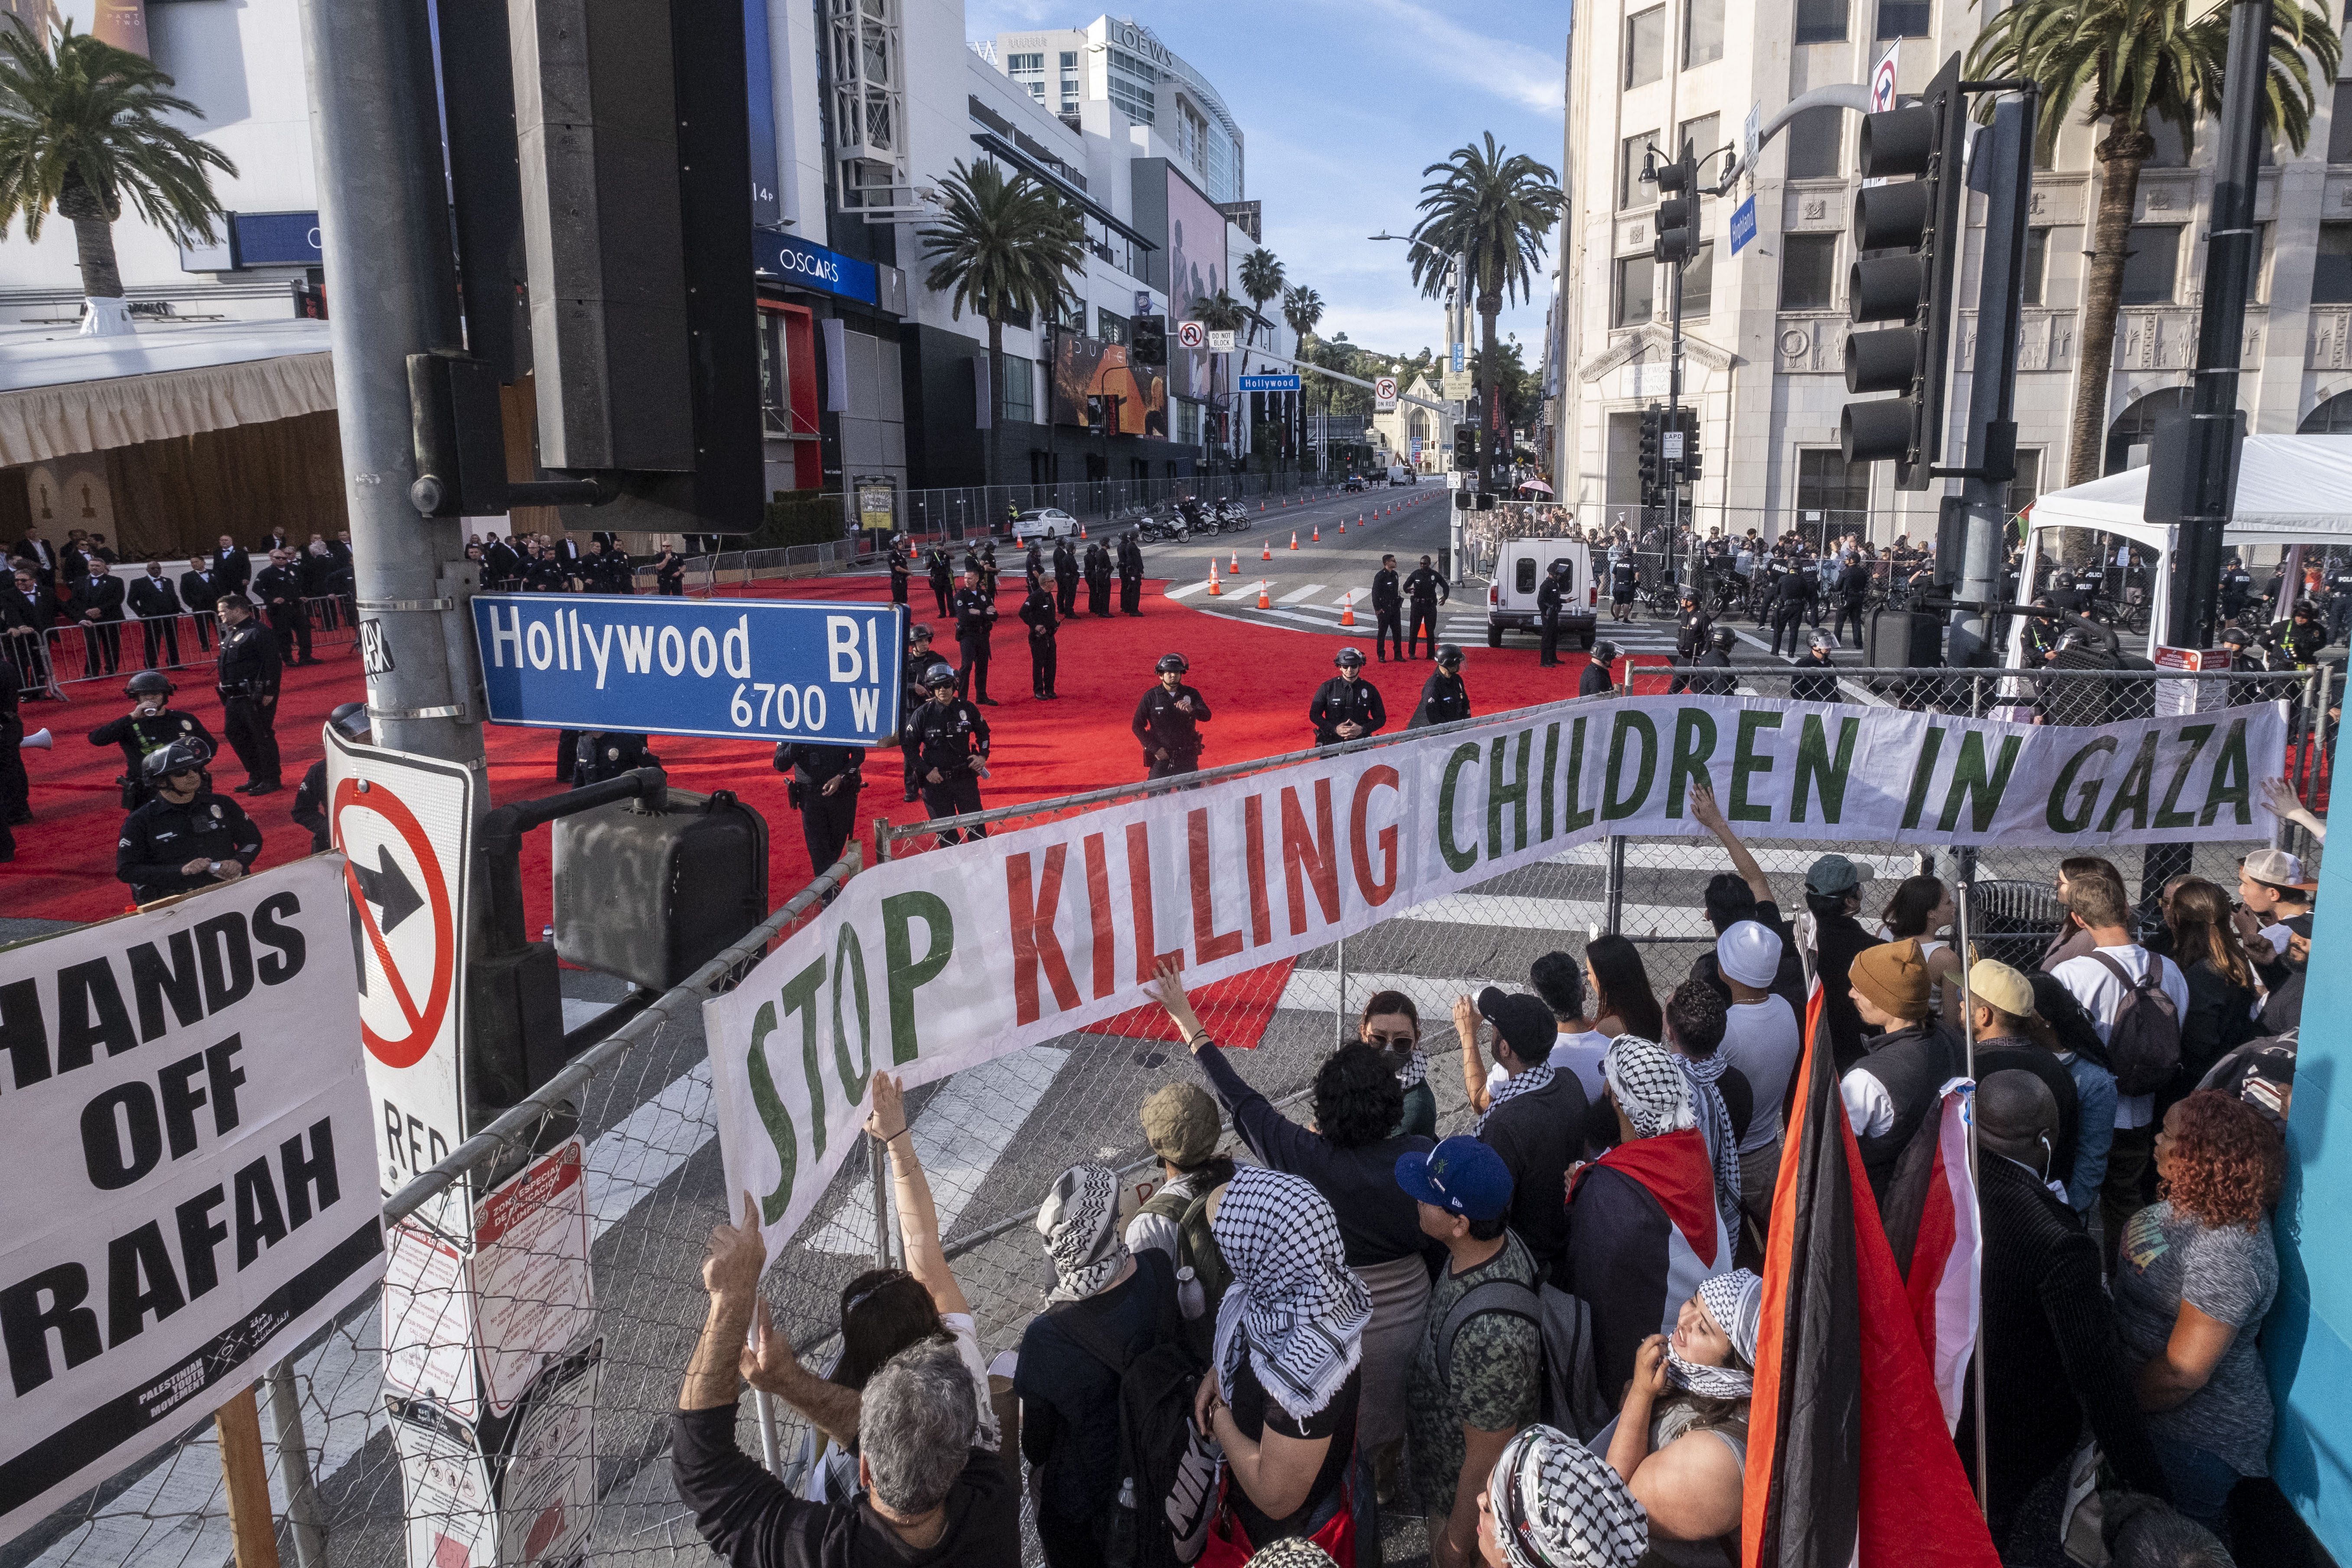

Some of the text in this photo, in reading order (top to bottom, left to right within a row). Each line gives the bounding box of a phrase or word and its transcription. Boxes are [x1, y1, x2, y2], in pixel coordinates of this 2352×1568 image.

[1113, 22, 1173, 68] LOEWS
[1732, 204, 1754, 245] Highland
[780, 249, 839, 282] OSCARS
[1245, 378, 1293, 389] Hollywood
[1630, 365, 1670, 375] HOLLYWOO
[490, 605, 750, 689] Hollywood
[730, 683, 879, 732] 6700 W
[746, 706, 2253, 1227] STOP KILLING CHILDREN IN GAZA
[0, 891, 306, 1096] HANDS
[80, 1031, 247, 1191] OFF
[384, 1099, 449, 1176] RED
[519, 1164, 560, 1198] ESPECIAL
[495, 1213, 507, 1227] DE
[0, 1116, 341, 1399] RAFAH
[427, 1236, 446, 1252] ZONE
[250, 1312, 267, 1328] حركة
[251, 1314, 273, 1338] الشباب
[139, 1357, 203, 1405] PALESTINIAN
[150, 1375, 205, 1418] MOVEMENT
[172, 1366, 205, 1393] YOUTH
